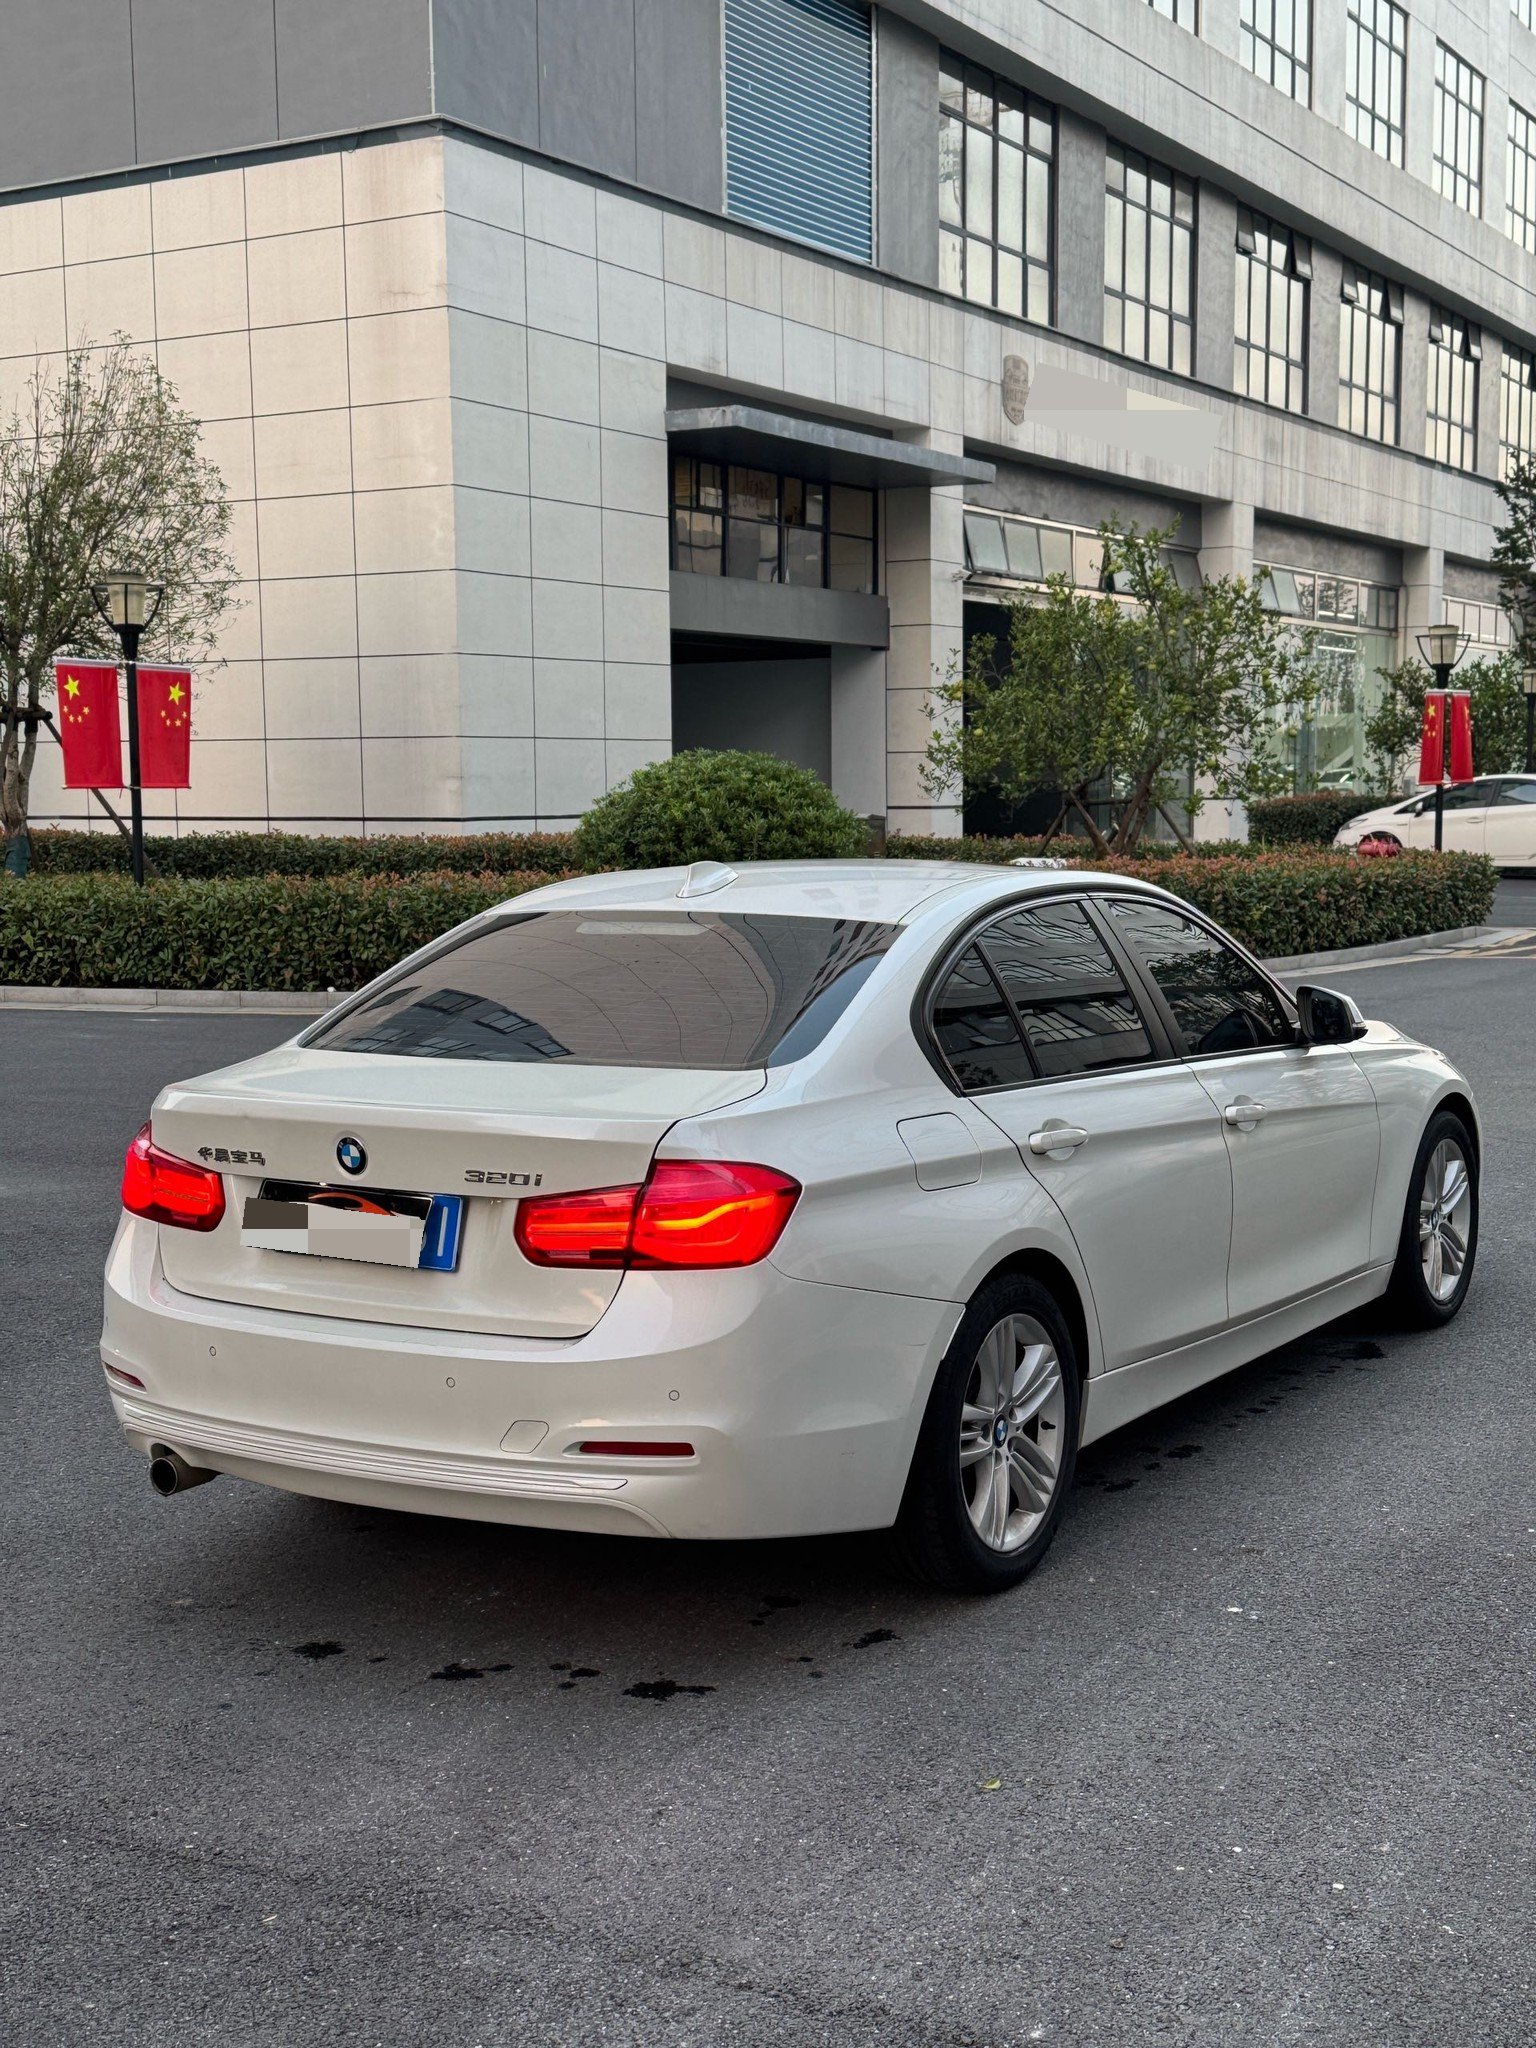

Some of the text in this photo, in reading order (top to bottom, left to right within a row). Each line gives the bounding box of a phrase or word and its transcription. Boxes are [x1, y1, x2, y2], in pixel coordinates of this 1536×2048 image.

[197, 1146, 266, 1166] 华晨宝马
[464, 1169, 543, 1187] 320i
